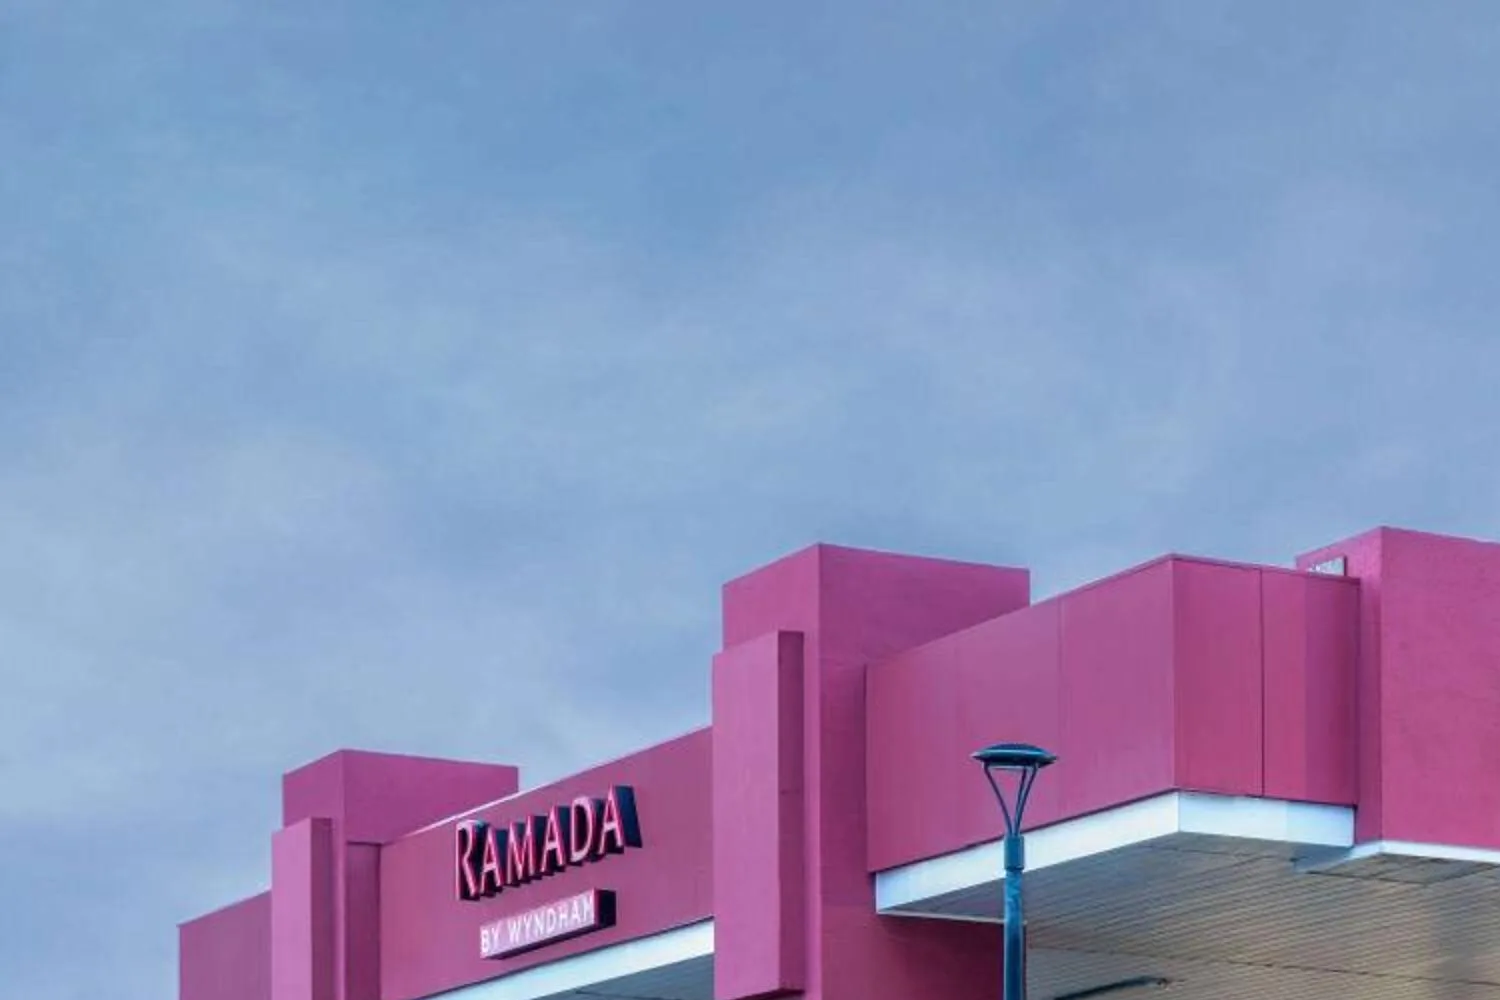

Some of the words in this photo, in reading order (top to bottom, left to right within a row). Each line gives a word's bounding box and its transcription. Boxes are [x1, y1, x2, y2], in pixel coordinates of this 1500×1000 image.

[455, 783, 641, 901] RAMADA
[481, 922, 502, 953] BY
[507, 893, 594, 943] WYNDHAM
